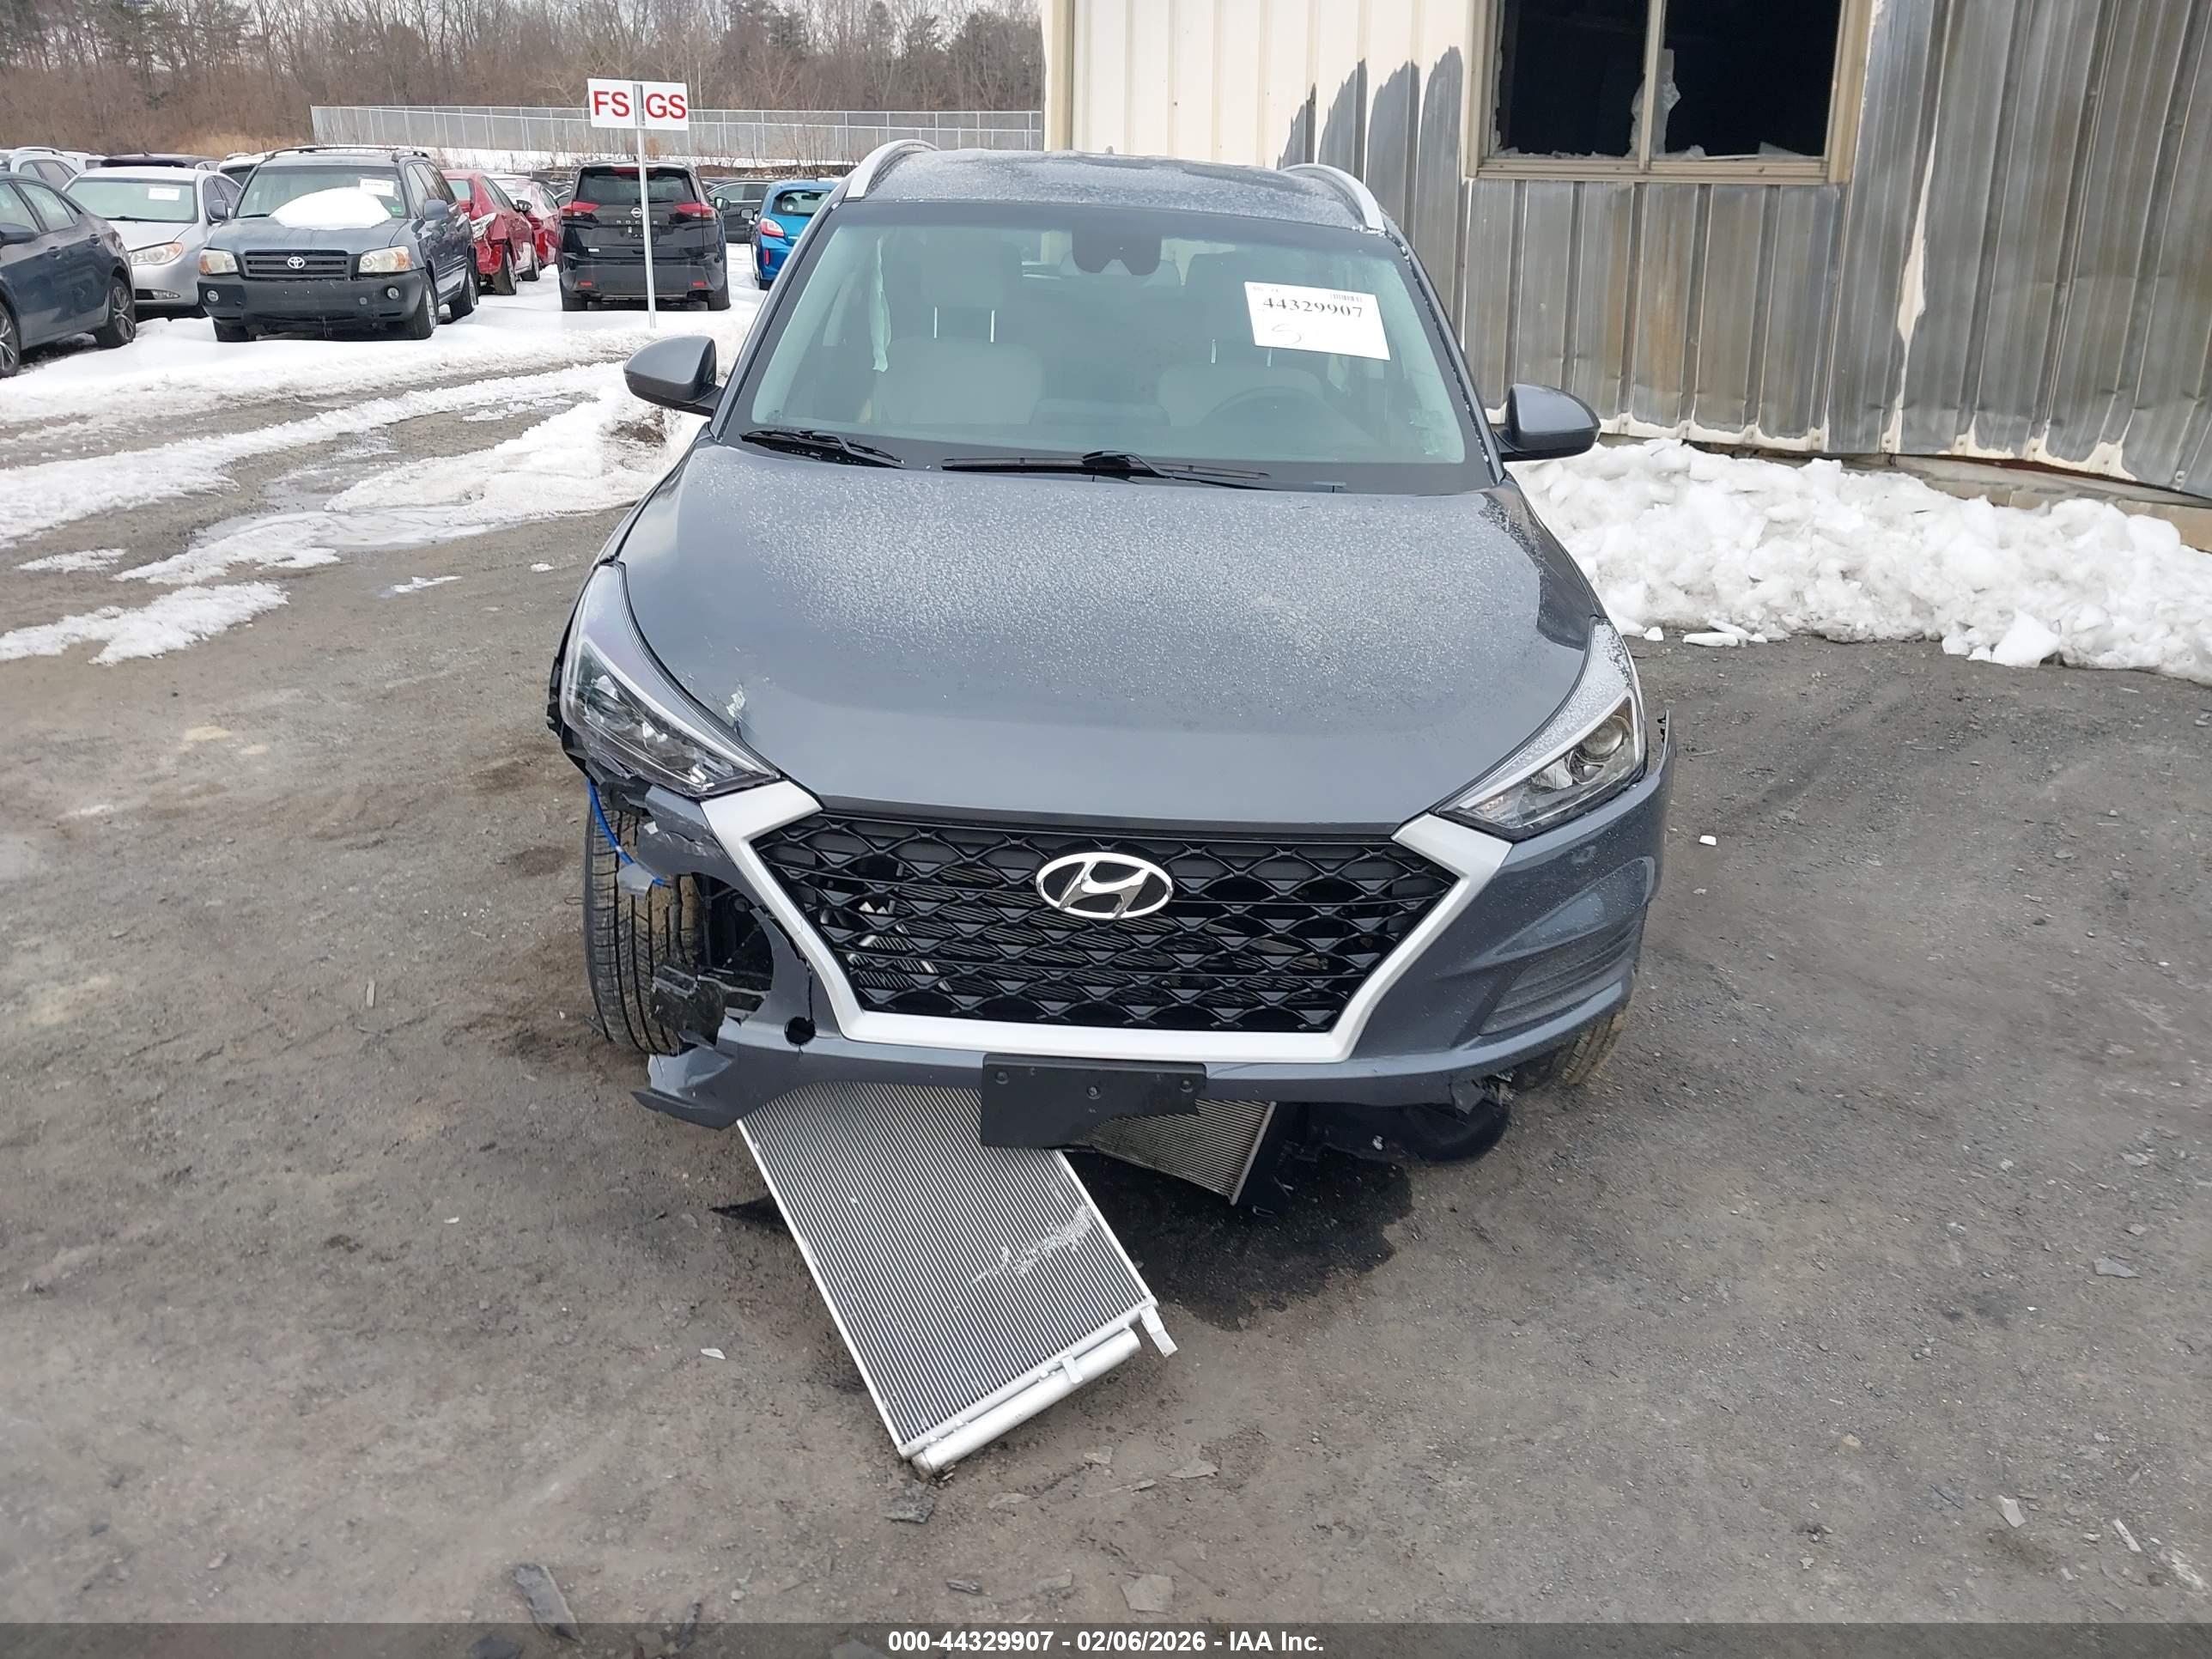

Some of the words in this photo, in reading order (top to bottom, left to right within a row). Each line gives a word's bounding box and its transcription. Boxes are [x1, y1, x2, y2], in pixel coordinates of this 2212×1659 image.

[593, 90, 630, 117] FS
[646, 93, 687, 118] GS
[1263, 297, 1363, 318] 44329907
